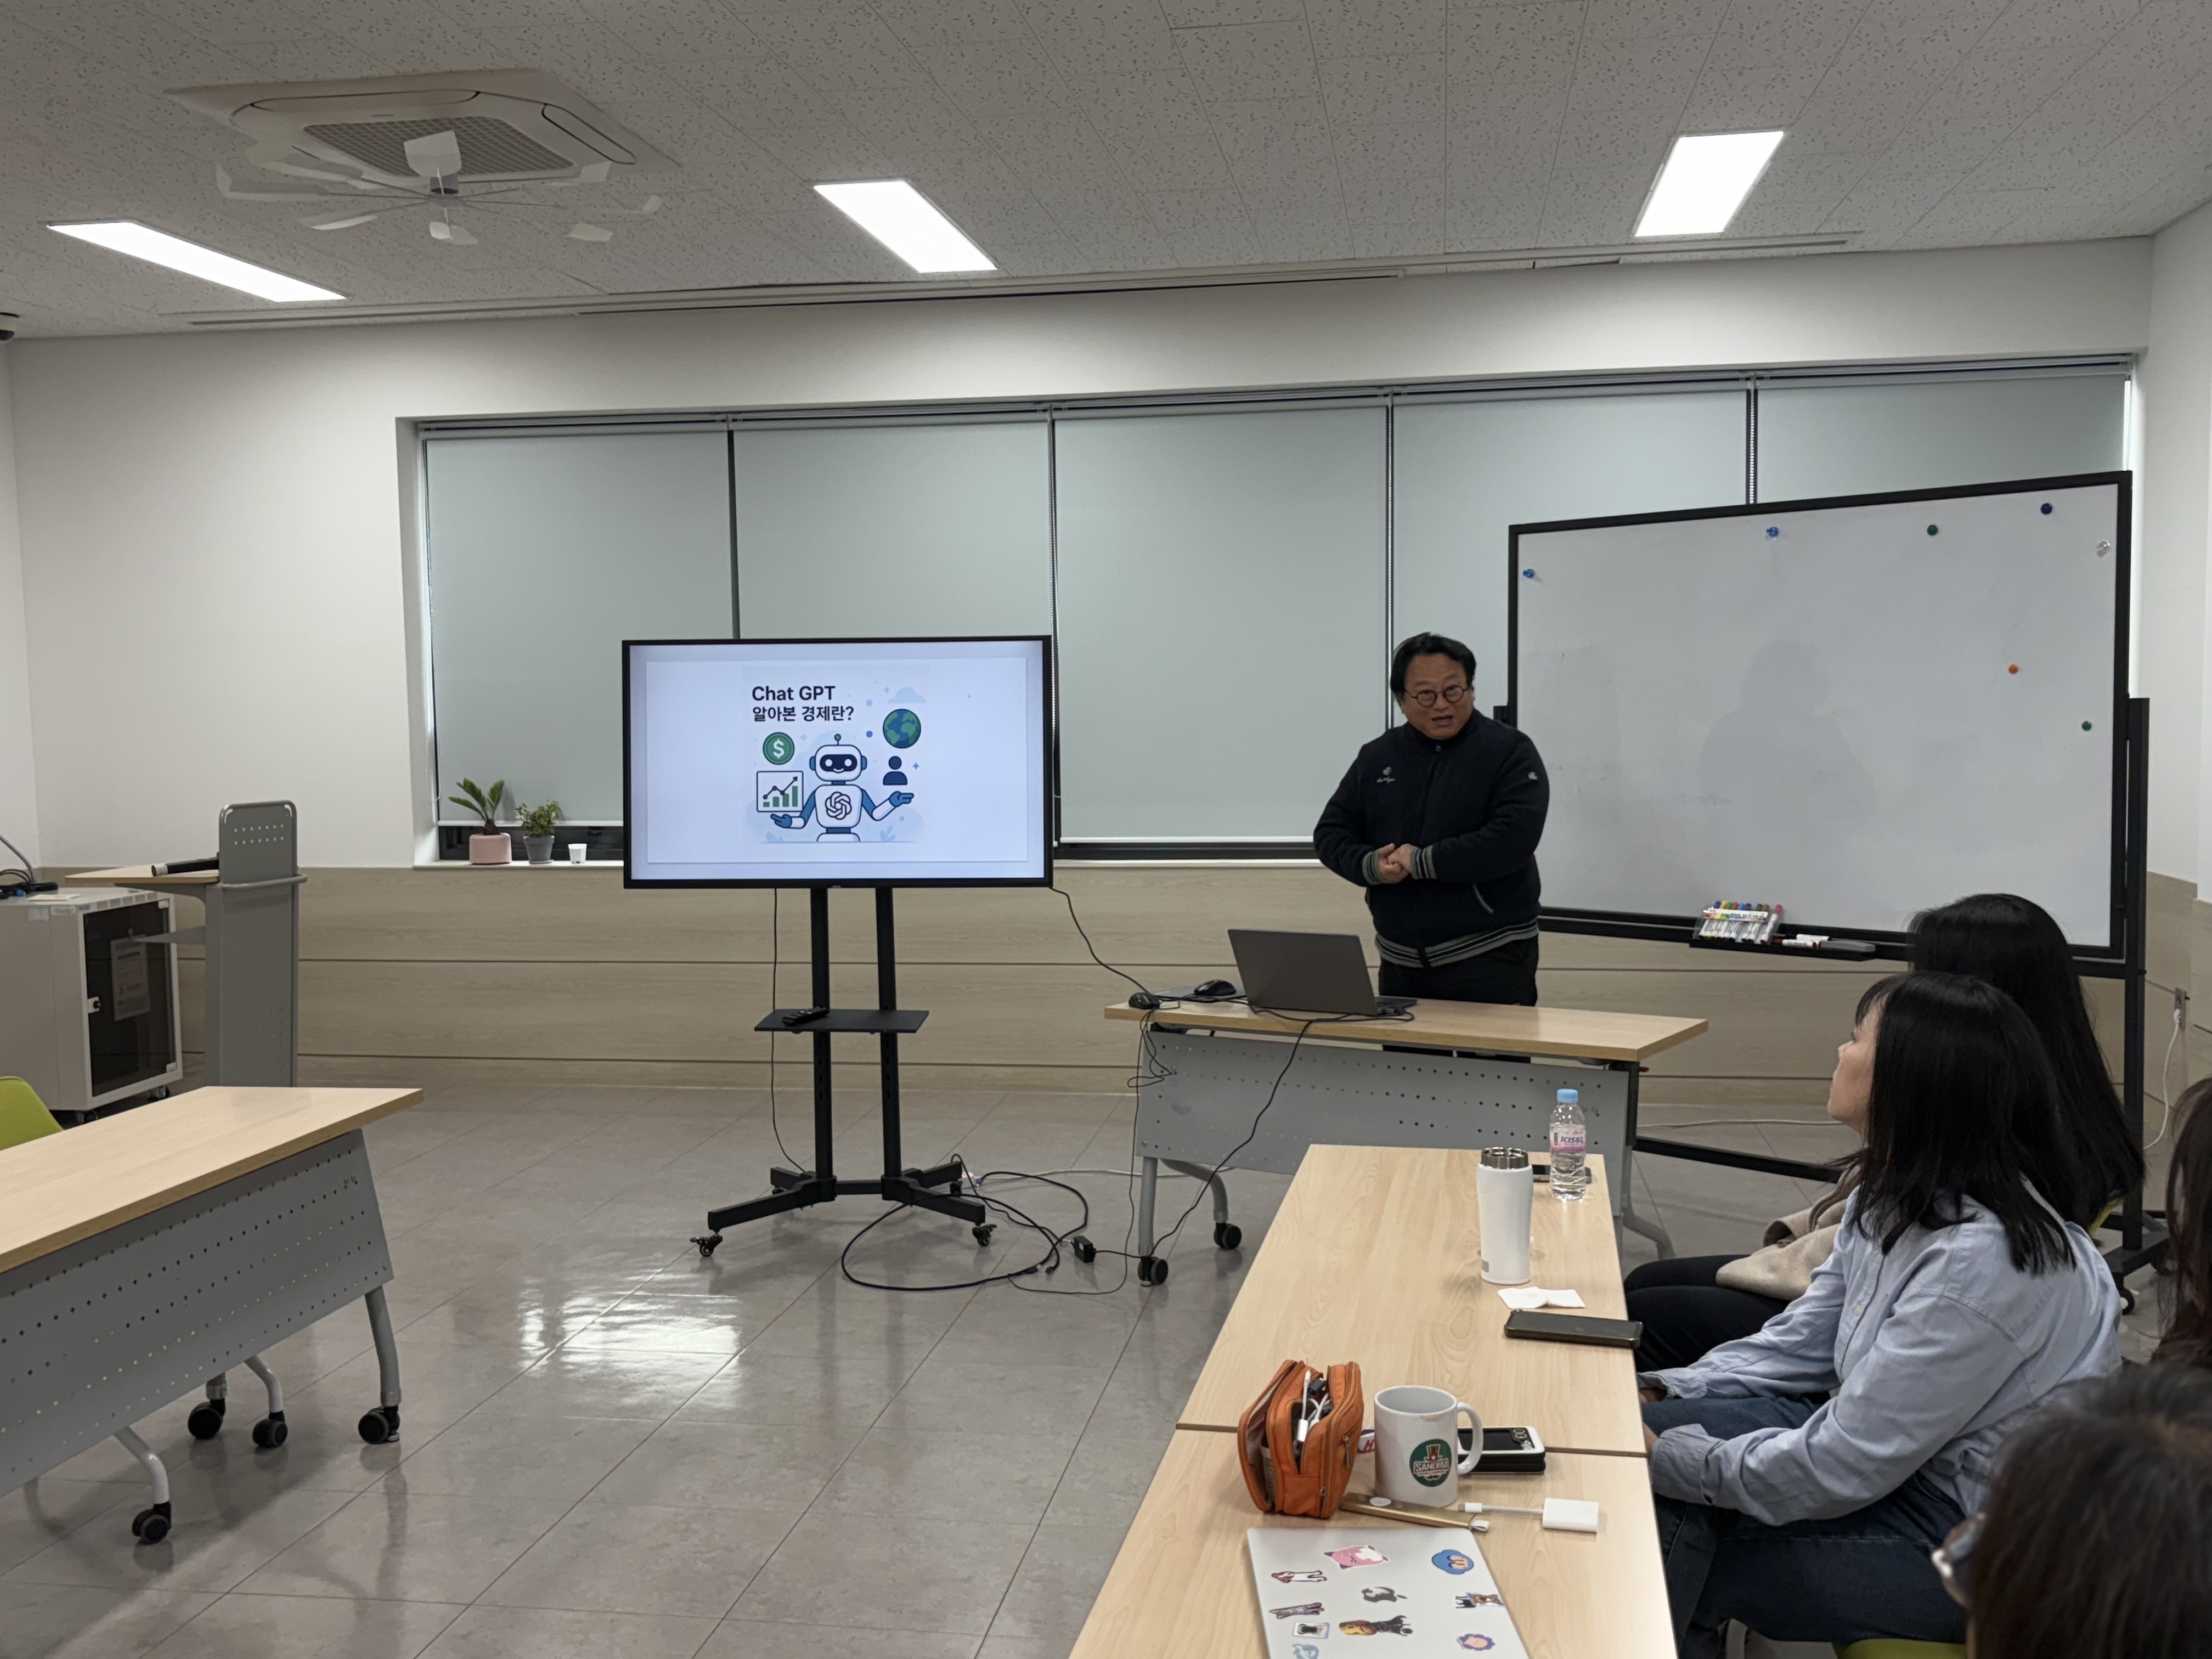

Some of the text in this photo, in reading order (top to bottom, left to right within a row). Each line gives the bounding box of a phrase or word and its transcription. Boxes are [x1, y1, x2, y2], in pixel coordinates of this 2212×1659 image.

[752, 686, 836, 701] Chat GPT
[753, 706, 854, 722] 알아본 경제란?
